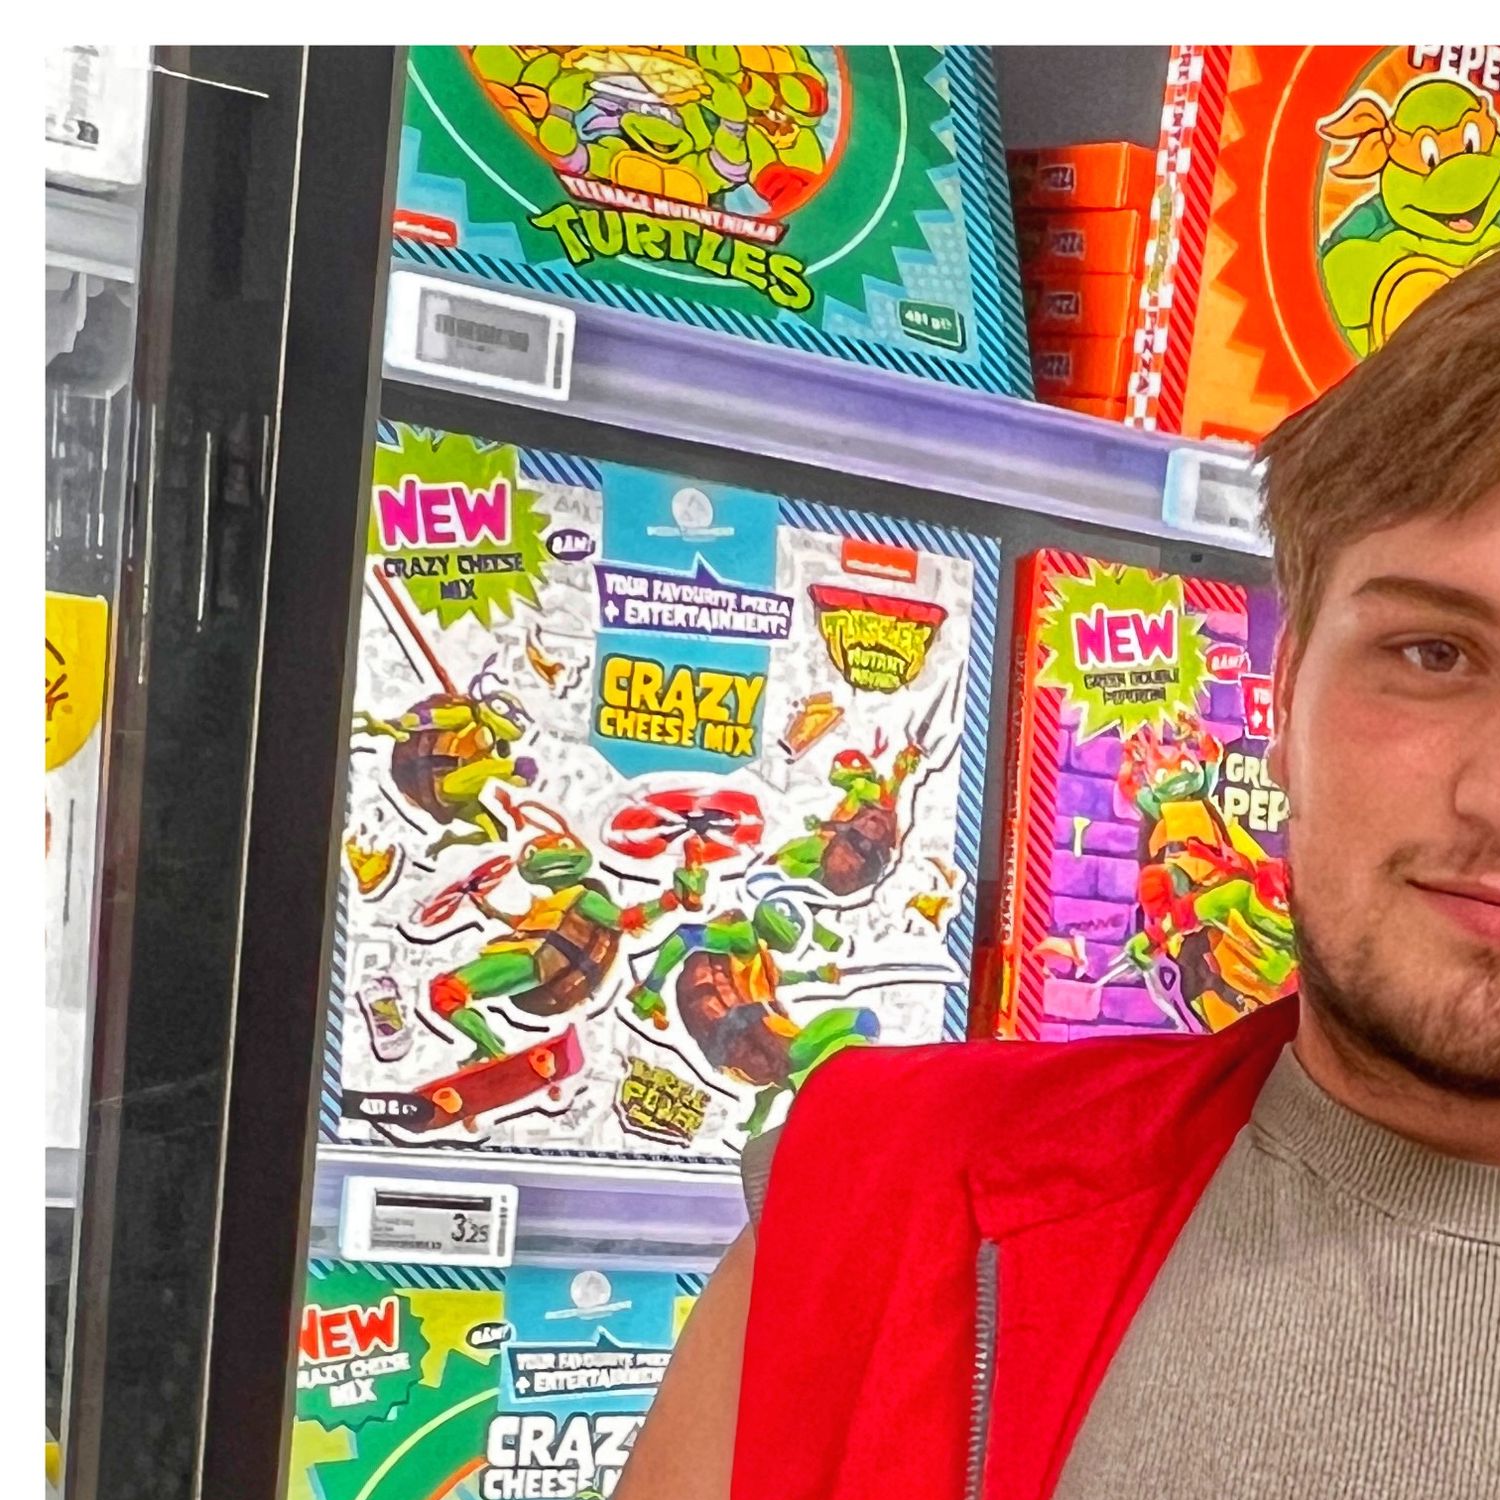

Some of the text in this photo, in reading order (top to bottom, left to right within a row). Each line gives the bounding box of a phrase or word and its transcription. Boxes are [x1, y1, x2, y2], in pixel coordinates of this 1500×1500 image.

[528, 205, 812, 309] TURTLES
[378, 479, 507, 547] NEW
[383, 554, 449, 579] CRAZY
[440, 579, 478, 600] MIX
[604, 573, 648, 598] YOUR
[1074, 608, 1175, 666] NEW
[604, 657, 765, 724] CRAZY
[600, 706, 755, 758] CHEESE MIX
